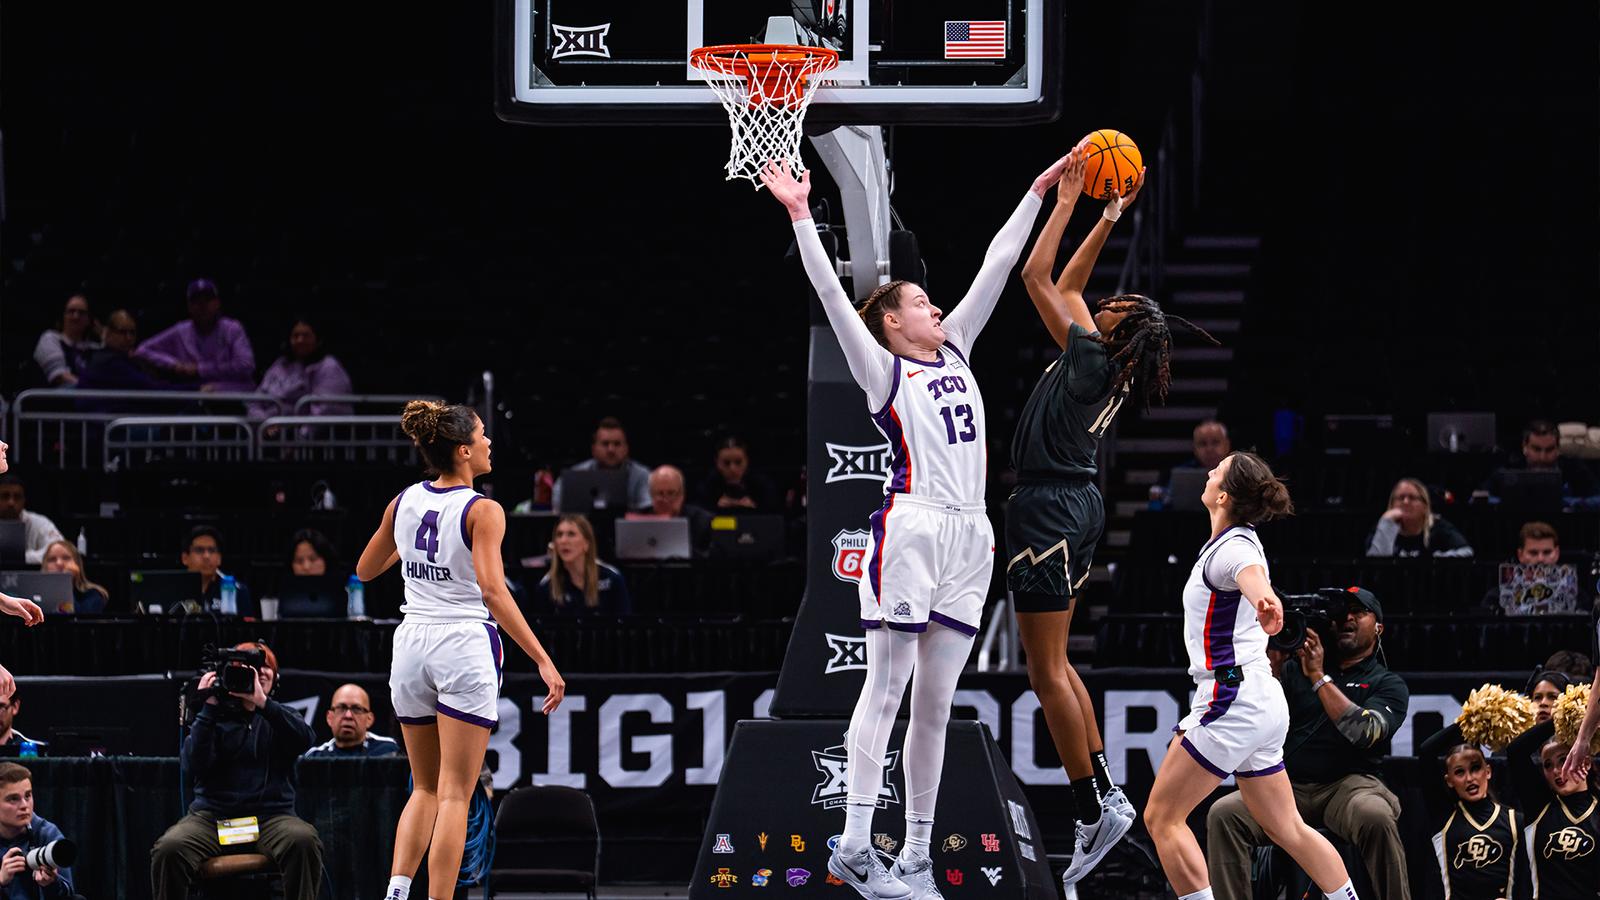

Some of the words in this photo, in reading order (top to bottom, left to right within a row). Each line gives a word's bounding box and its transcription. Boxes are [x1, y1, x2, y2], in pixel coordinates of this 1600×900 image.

[927, 375, 967, 400] TCU
[939, 403, 976, 445] 13
[415, 509, 440, 564] 4
[840, 538, 867, 548] PHILLI
[406, 561, 453, 581] HUNTER
[710, 874, 738, 883] STATE
